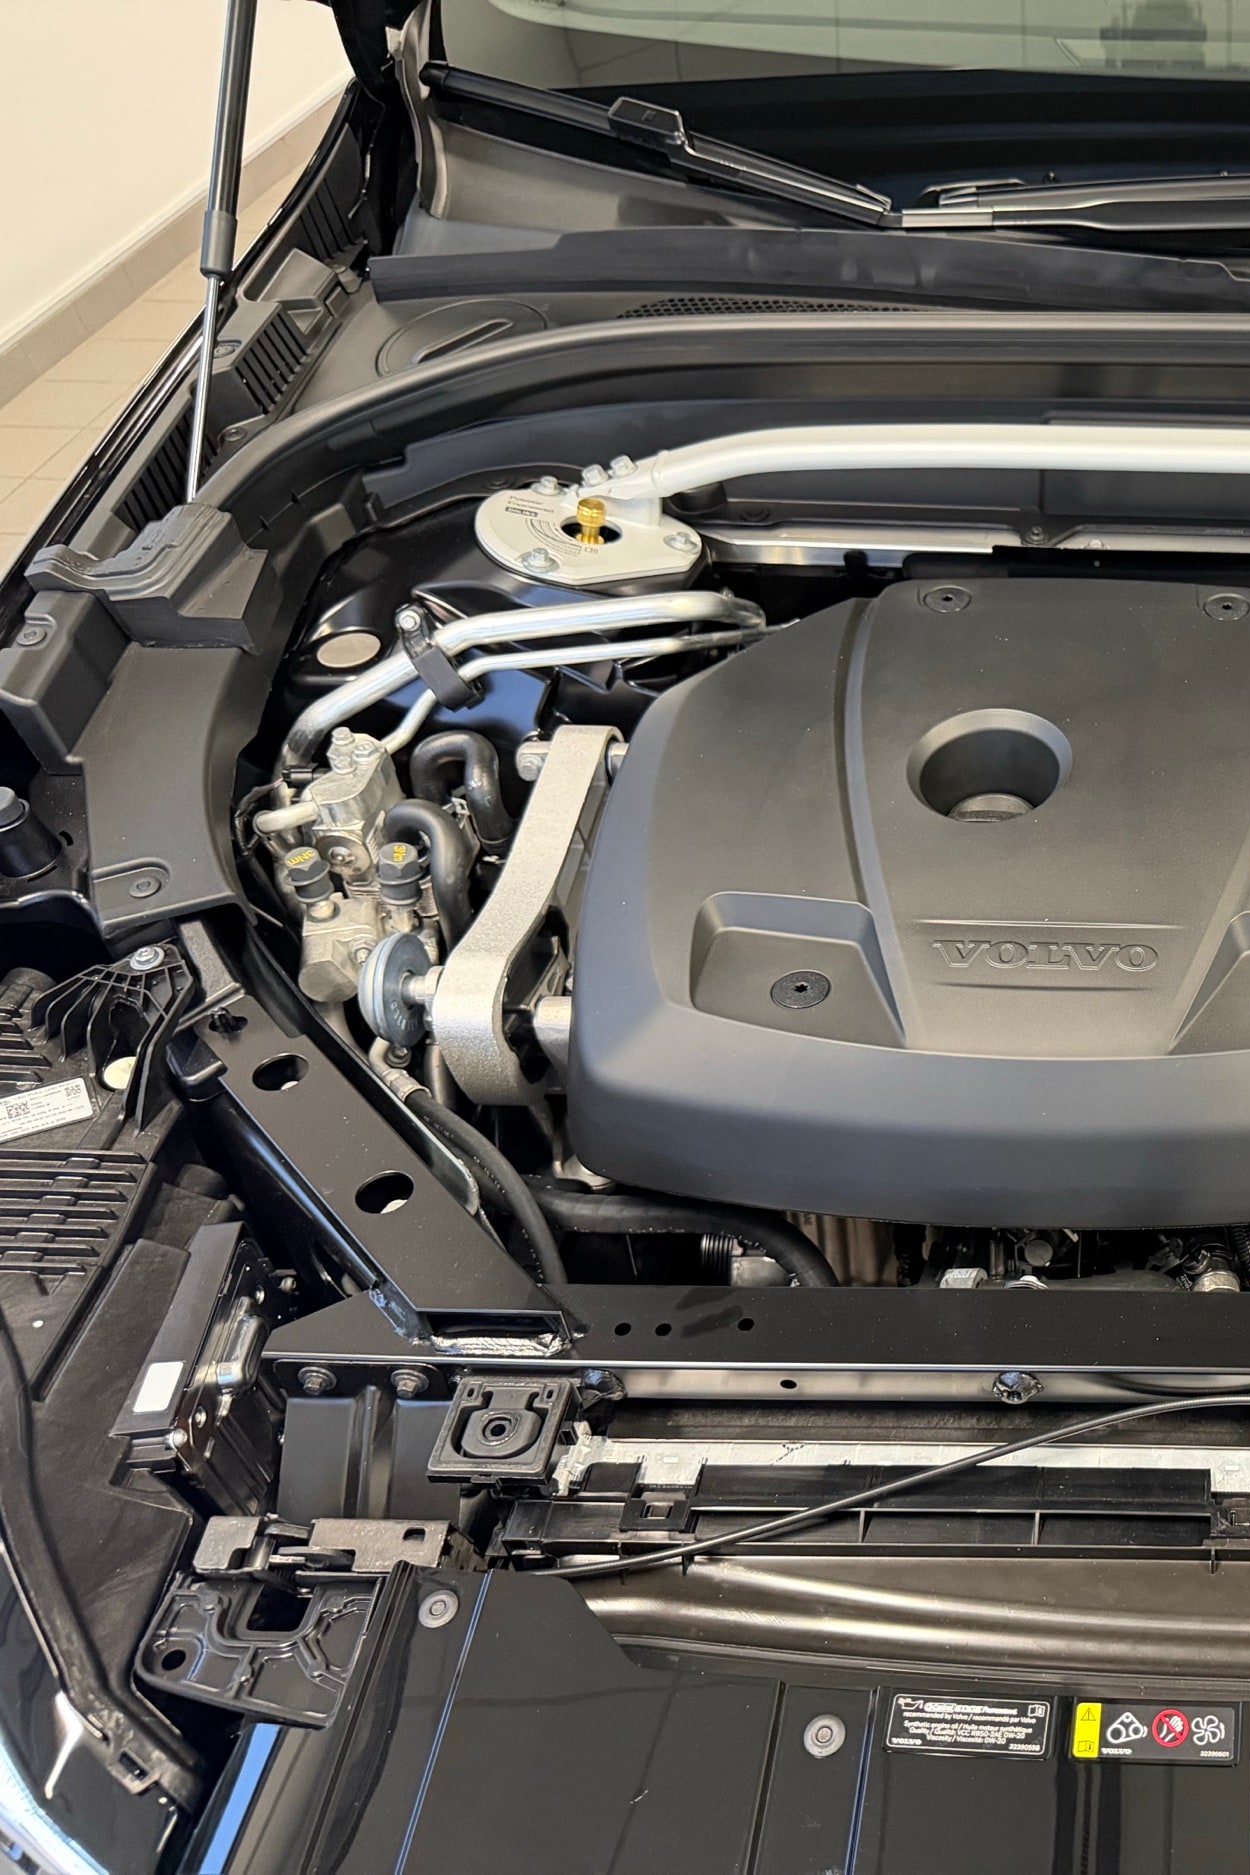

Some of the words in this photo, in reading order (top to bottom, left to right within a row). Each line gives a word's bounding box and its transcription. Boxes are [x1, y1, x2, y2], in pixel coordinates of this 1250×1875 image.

[288, 850, 314, 865] 3Nm
[932, 940, 1159, 972] VOLVO
[904, 1720, 931, 1728] Synthetic
[1020, 1716, 1037, 1724] Volvo
[909, 1727, 930, 1735] Quality
[926, 1734, 953, 1743] Viscosity
[1101, 1747, 1132, 1756] VOLVO
